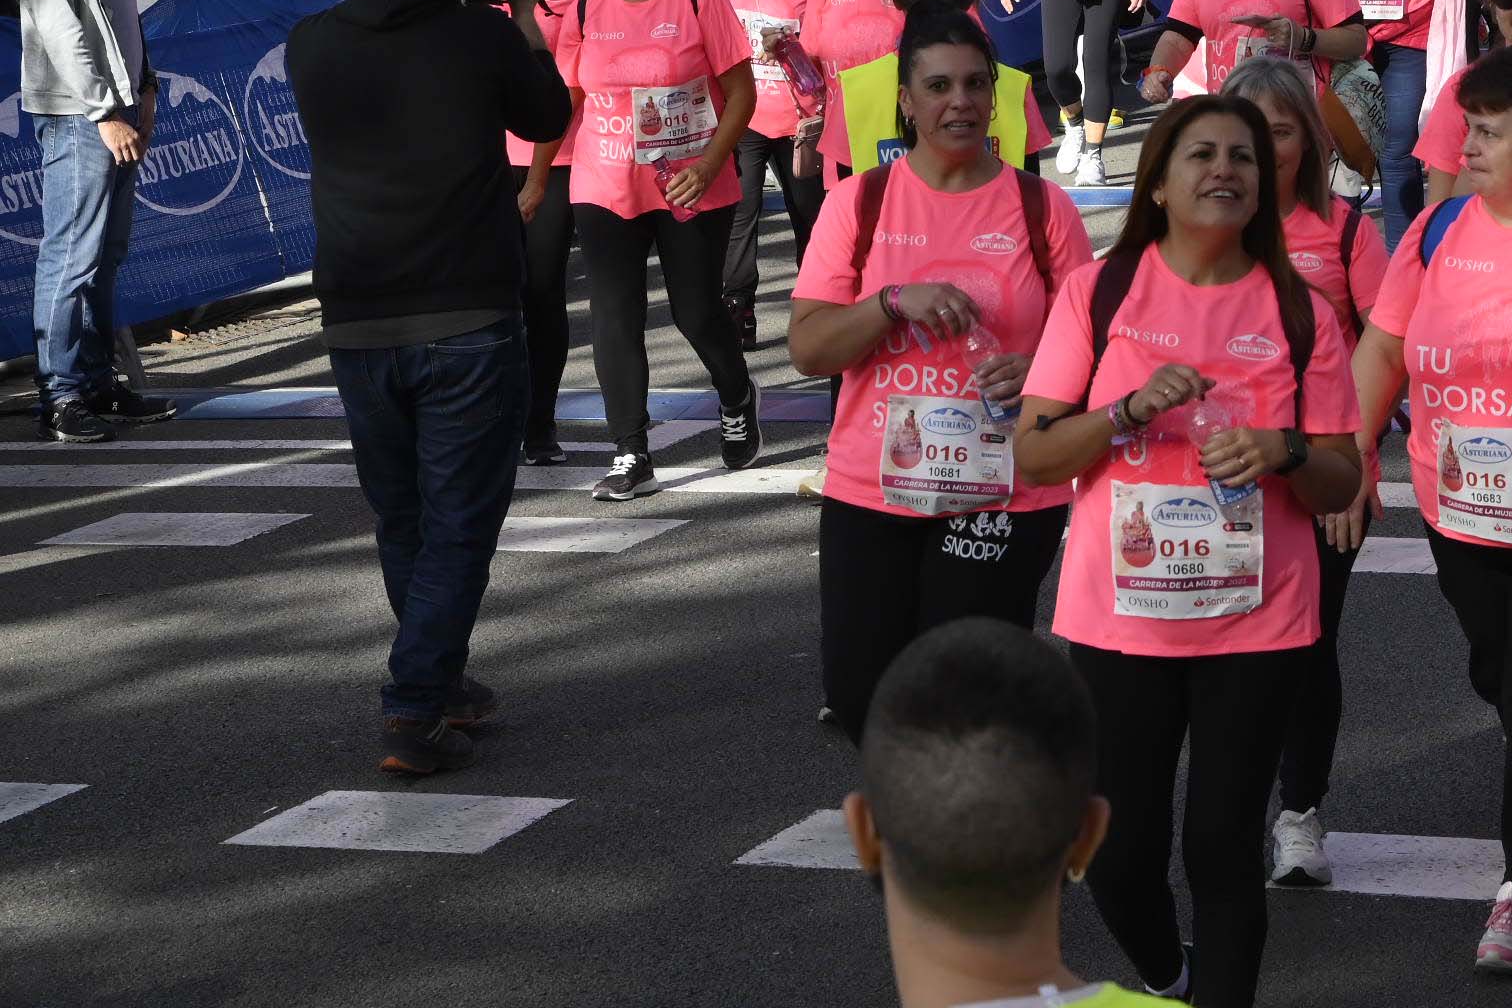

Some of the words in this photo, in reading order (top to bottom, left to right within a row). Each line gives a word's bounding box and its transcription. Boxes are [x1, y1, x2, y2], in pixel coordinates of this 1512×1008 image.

[590, 31, 625, 41] OYSHO
[588, 92, 613, 109] TU
[664, 112, 689, 128] 016
[875, 231, 927, 247] OYSHO
[972, 238, 1017, 253] ASTURIANA
[1444, 255, 1494, 273] OYSHO
[1117, 325, 1180, 348] OYSHO
[1230, 342, 1277, 357] ASTURIANA
[1416, 344, 1451, 375] TU
[923, 417, 975, 433] ASTURIANA
[924, 445, 969, 464] 016
[1462, 447, 1508, 459] ASTURIANA
[928, 465, 962, 479] 10681
[893, 478, 929, 490] CARRERA
[929, 481, 940, 490] DE
[940, 482, 951, 491] LA
[952, 482, 979, 493] MUJER
[1465, 472, 1507, 489] 016
[1470, 491, 1502, 504] 10683
[1155, 508, 1213, 522] ASTURIANA
[1447, 500, 1473, 514] CARRERA
[1473, 506, 1483, 515] DE
[1484, 507, 1494, 516] LA
[941, 535, 1009, 562] SNOOPY
[1159, 539, 1211, 557] 016
[1165, 562, 1204, 575] 10680
[1129, 579, 1167, 588] CARRERA
[1168, 579, 1181, 589] DE
[1182, 580, 1194, 589] LA
[1194, 579, 1224, 588] MUJER
[1128, 596, 1169, 609] OYSHO
